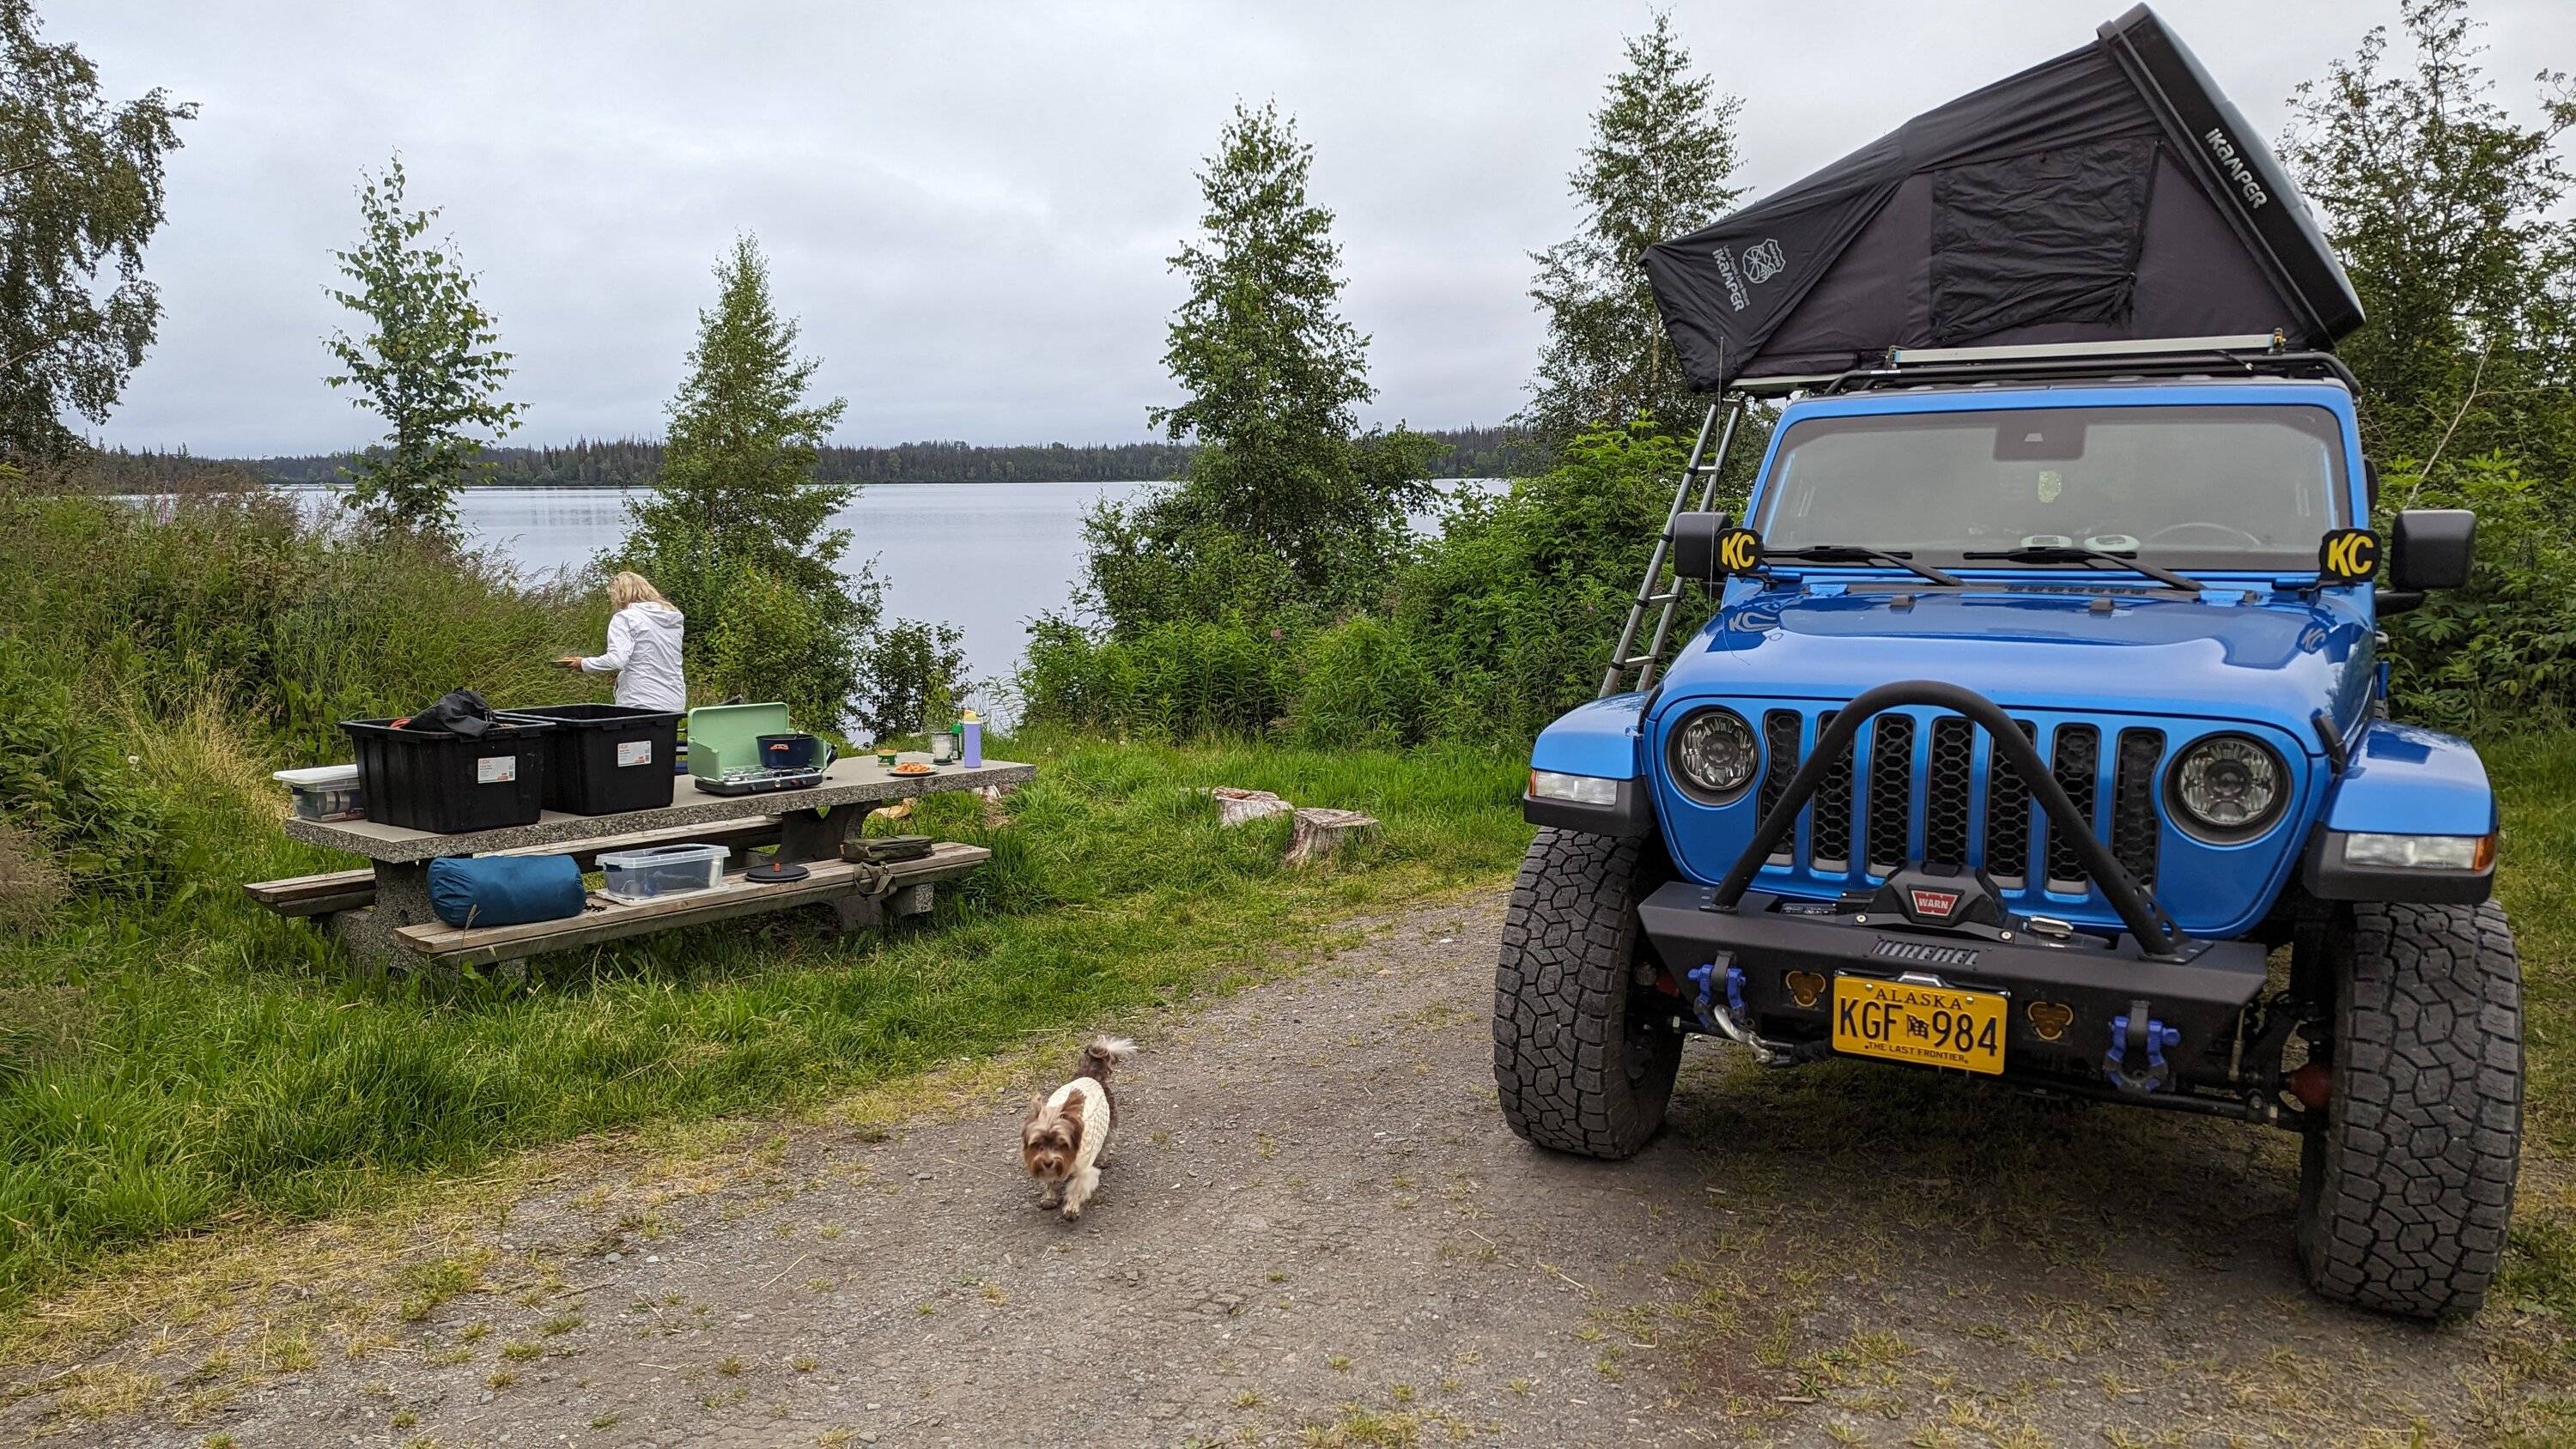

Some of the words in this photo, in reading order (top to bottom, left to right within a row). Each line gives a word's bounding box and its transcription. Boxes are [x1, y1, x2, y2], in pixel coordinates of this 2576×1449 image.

[1722, 532, 1755, 569] KC
[2328, 533, 2373, 577] KC
[1918, 898, 1948, 909] WARN
[1875, 988, 1963, 1010] ALASKA
[1840, 997, 1904, 1041] KGF
[1933, 1010, 1997, 1056] 984
[1868, 1041, 1886, 1052] THE
[1889, 1045, 1914, 1055] LAST
[1918, 1050, 1965, 1062] FRONTIER
